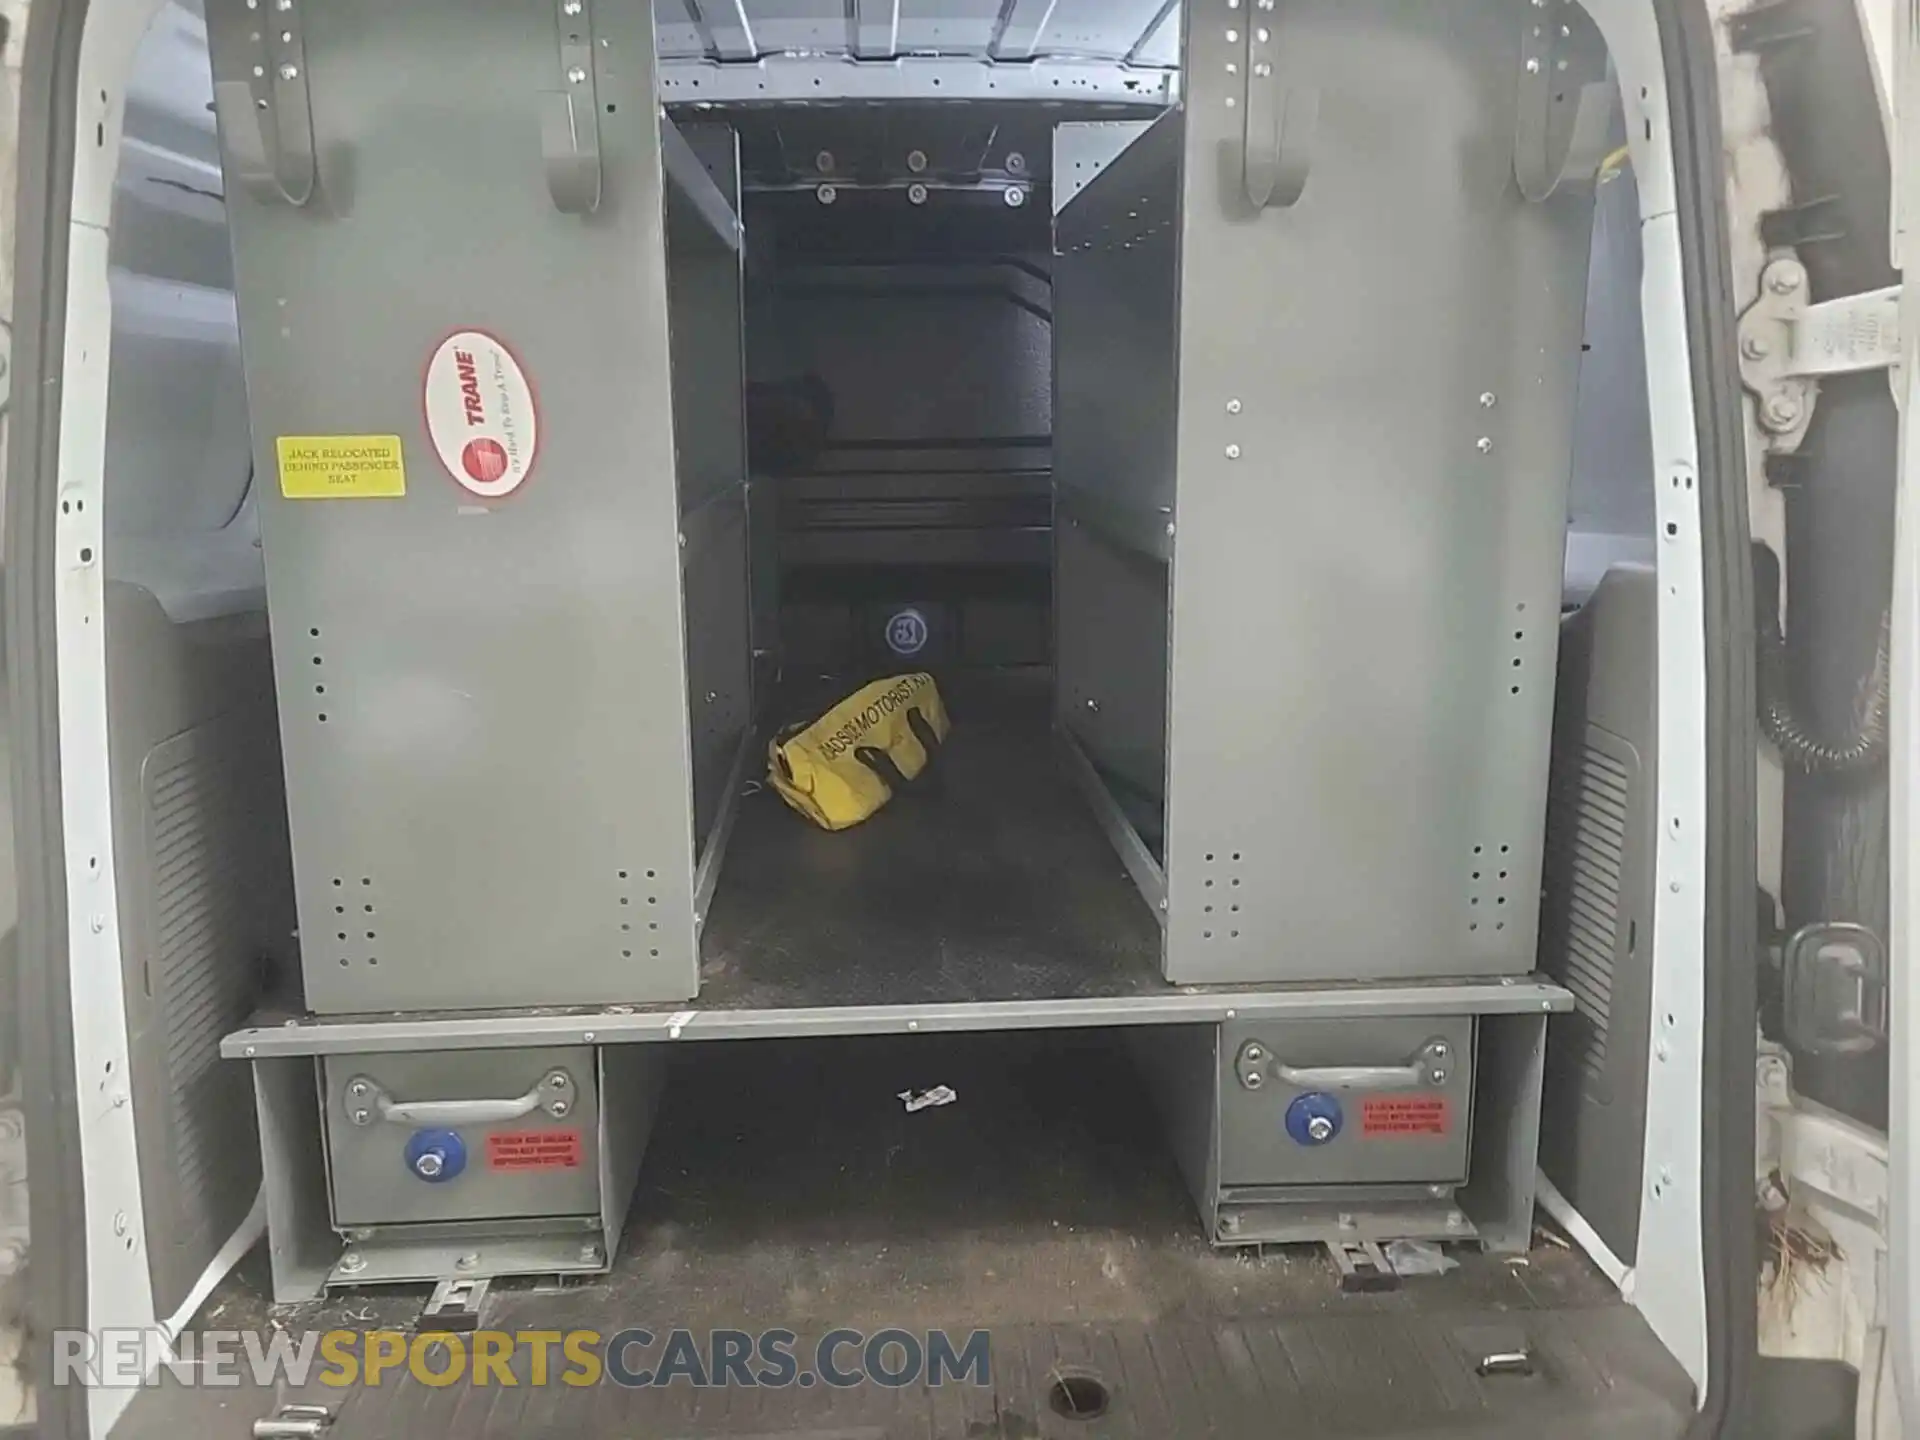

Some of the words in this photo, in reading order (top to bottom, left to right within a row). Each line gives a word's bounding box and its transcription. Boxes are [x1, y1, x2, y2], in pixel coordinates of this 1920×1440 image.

[454, 350, 485, 427] TRANE
[288, 449, 319, 461] JACK
[322, 448, 391, 459] RELOCATED
[284, 461, 329, 472] BEHIND
[331, 460, 400, 471] PASSENGER
[328, 474, 358, 484] SEAT
[854, 679, 915, 734] MOTORIST
